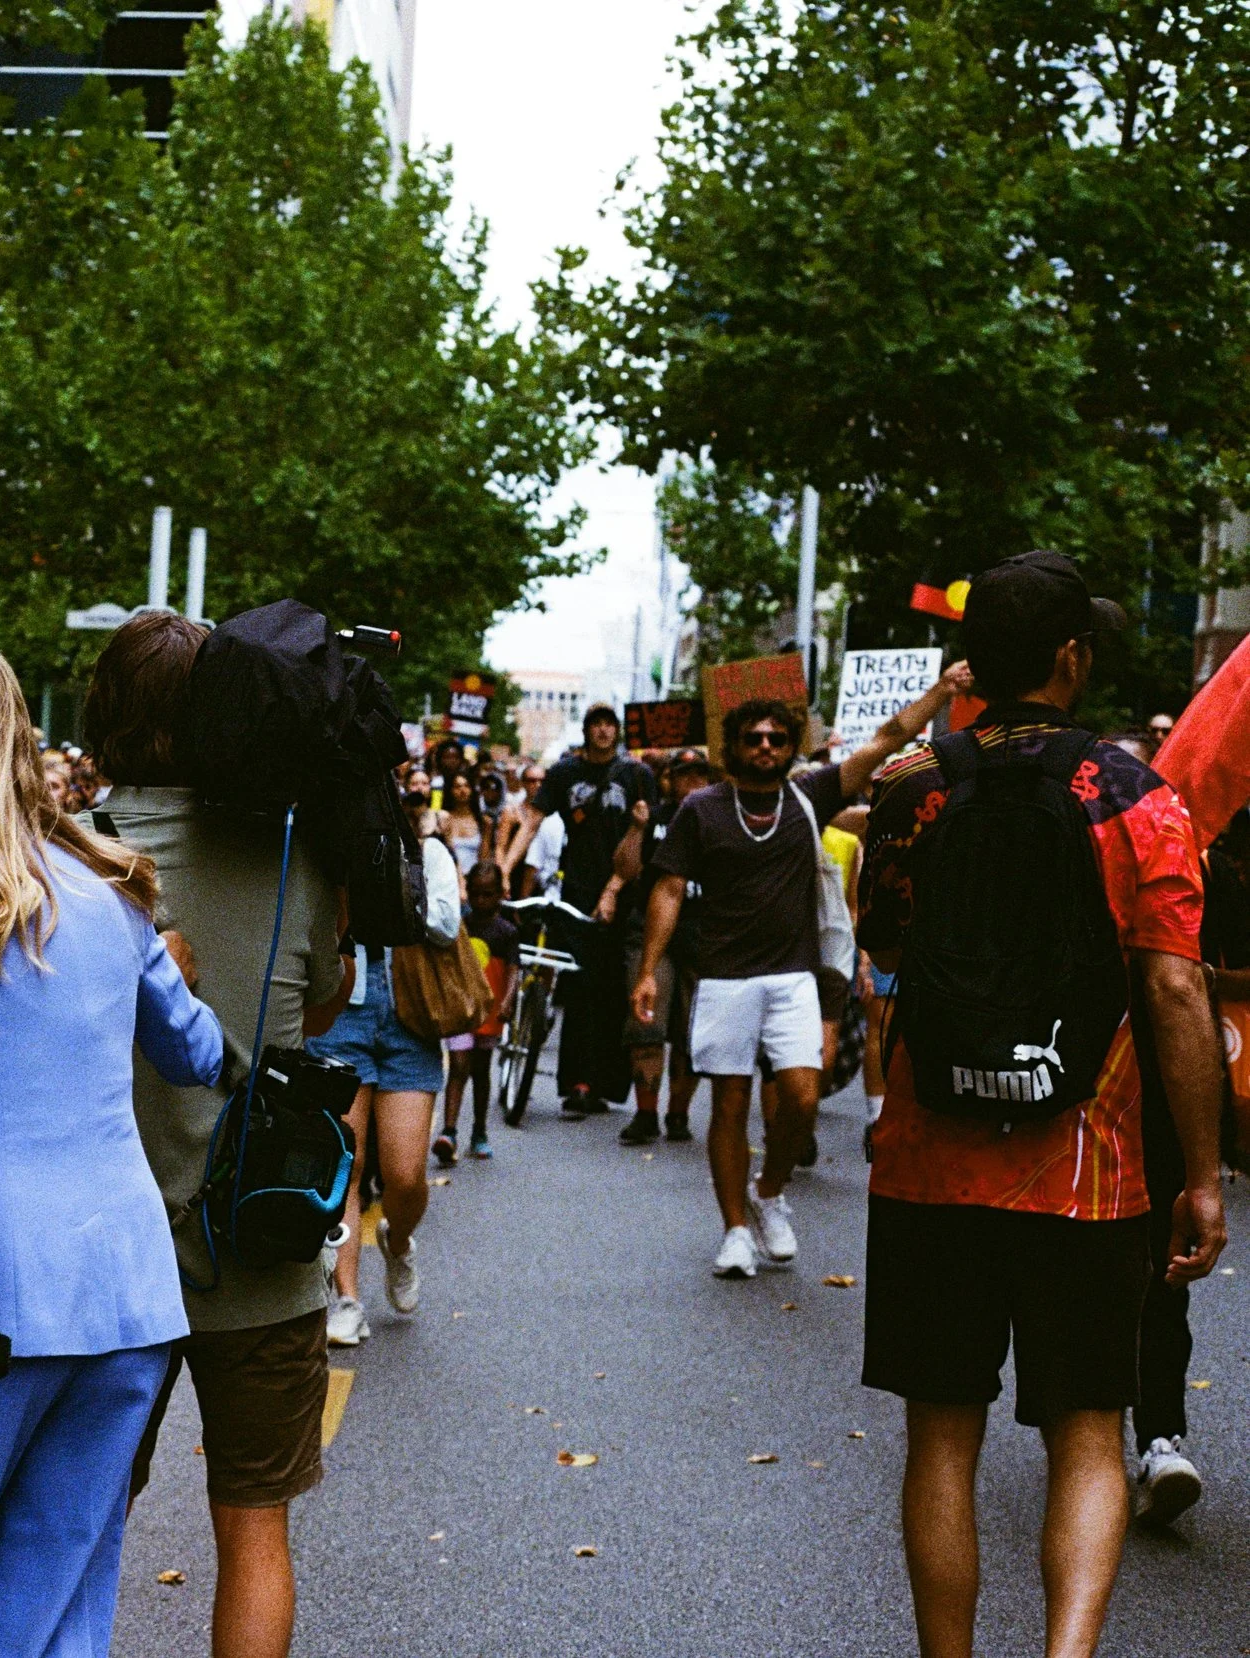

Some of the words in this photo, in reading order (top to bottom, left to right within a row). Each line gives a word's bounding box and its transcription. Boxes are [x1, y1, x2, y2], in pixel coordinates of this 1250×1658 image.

[851, 654, 928, 675] TREATY
[844, 674, 932, 698] JUSTICE
[952, 1063, 1055, 1102] PUMA
